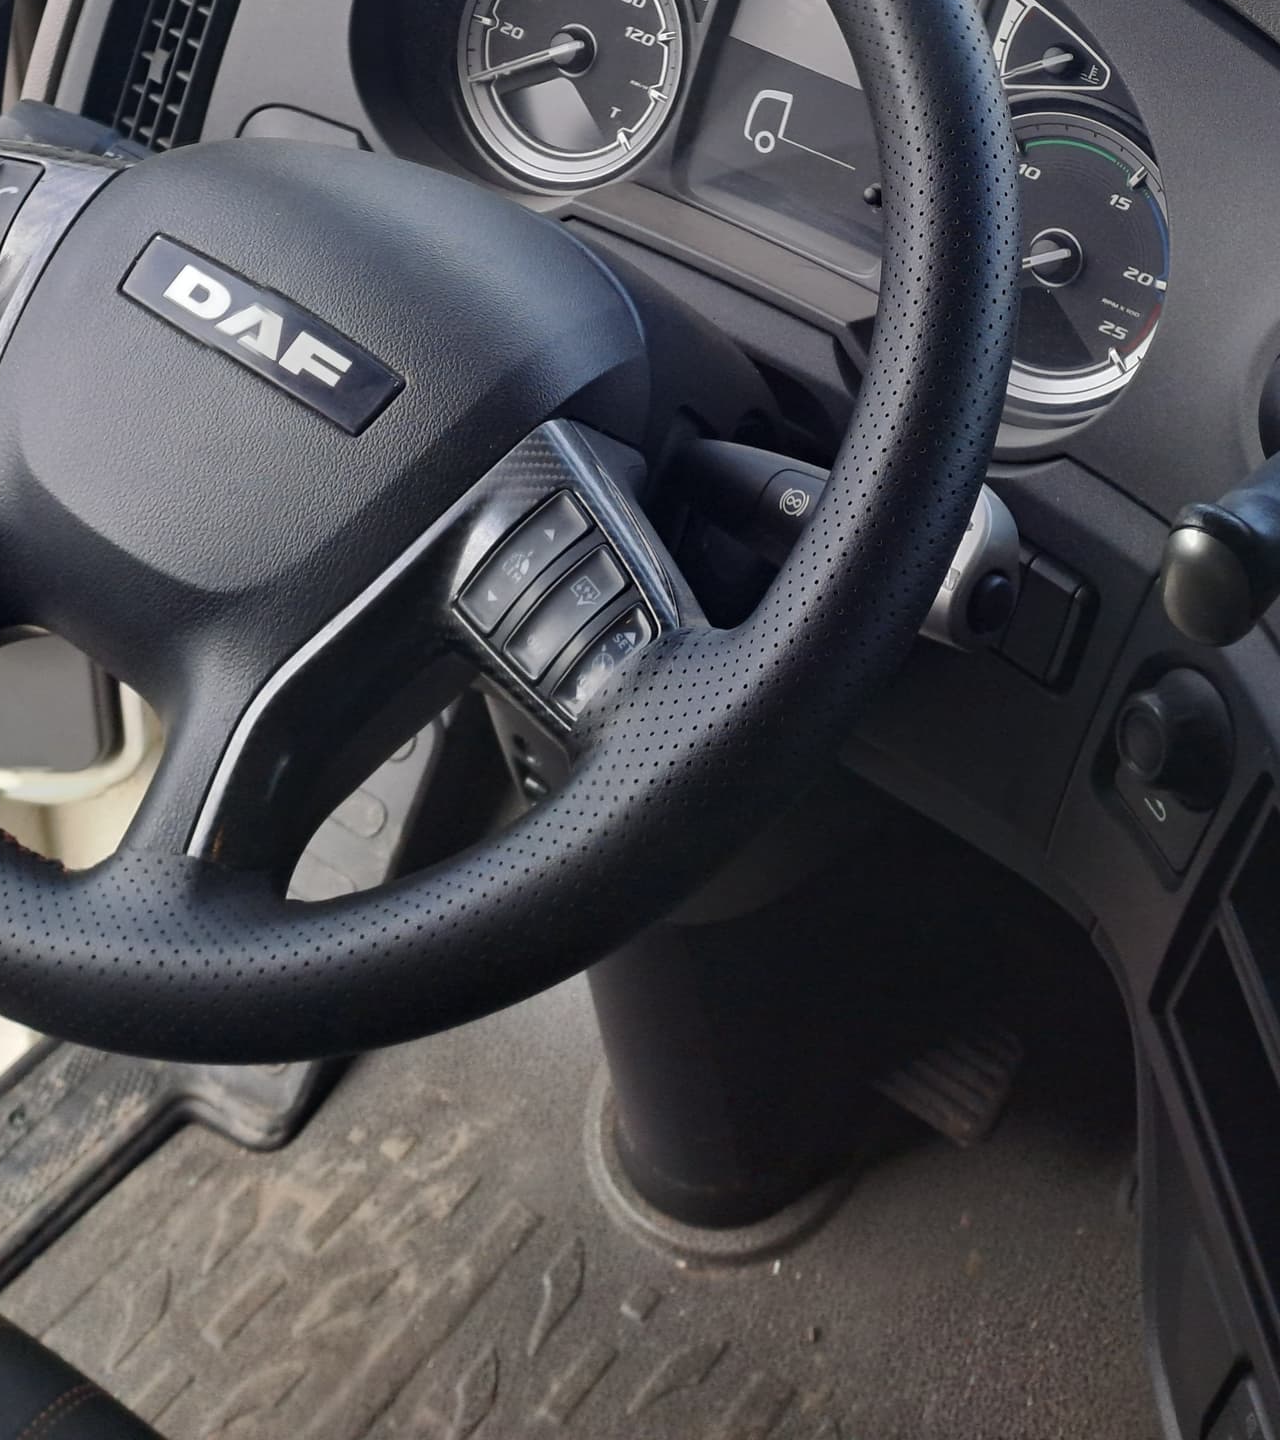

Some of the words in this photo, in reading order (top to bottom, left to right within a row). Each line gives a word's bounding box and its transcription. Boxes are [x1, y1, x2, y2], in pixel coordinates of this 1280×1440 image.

[500, 22, 524, 40] 20
[624, 26, 656, 46] 120
[1019, 163, 1041, 180] 10
[1109, 193, 1132, 210] 15
[1123, 266, 1154, 286] 20
[162, 263, 353, 388] DAF
[1098, 320, 1129, 340] 25
